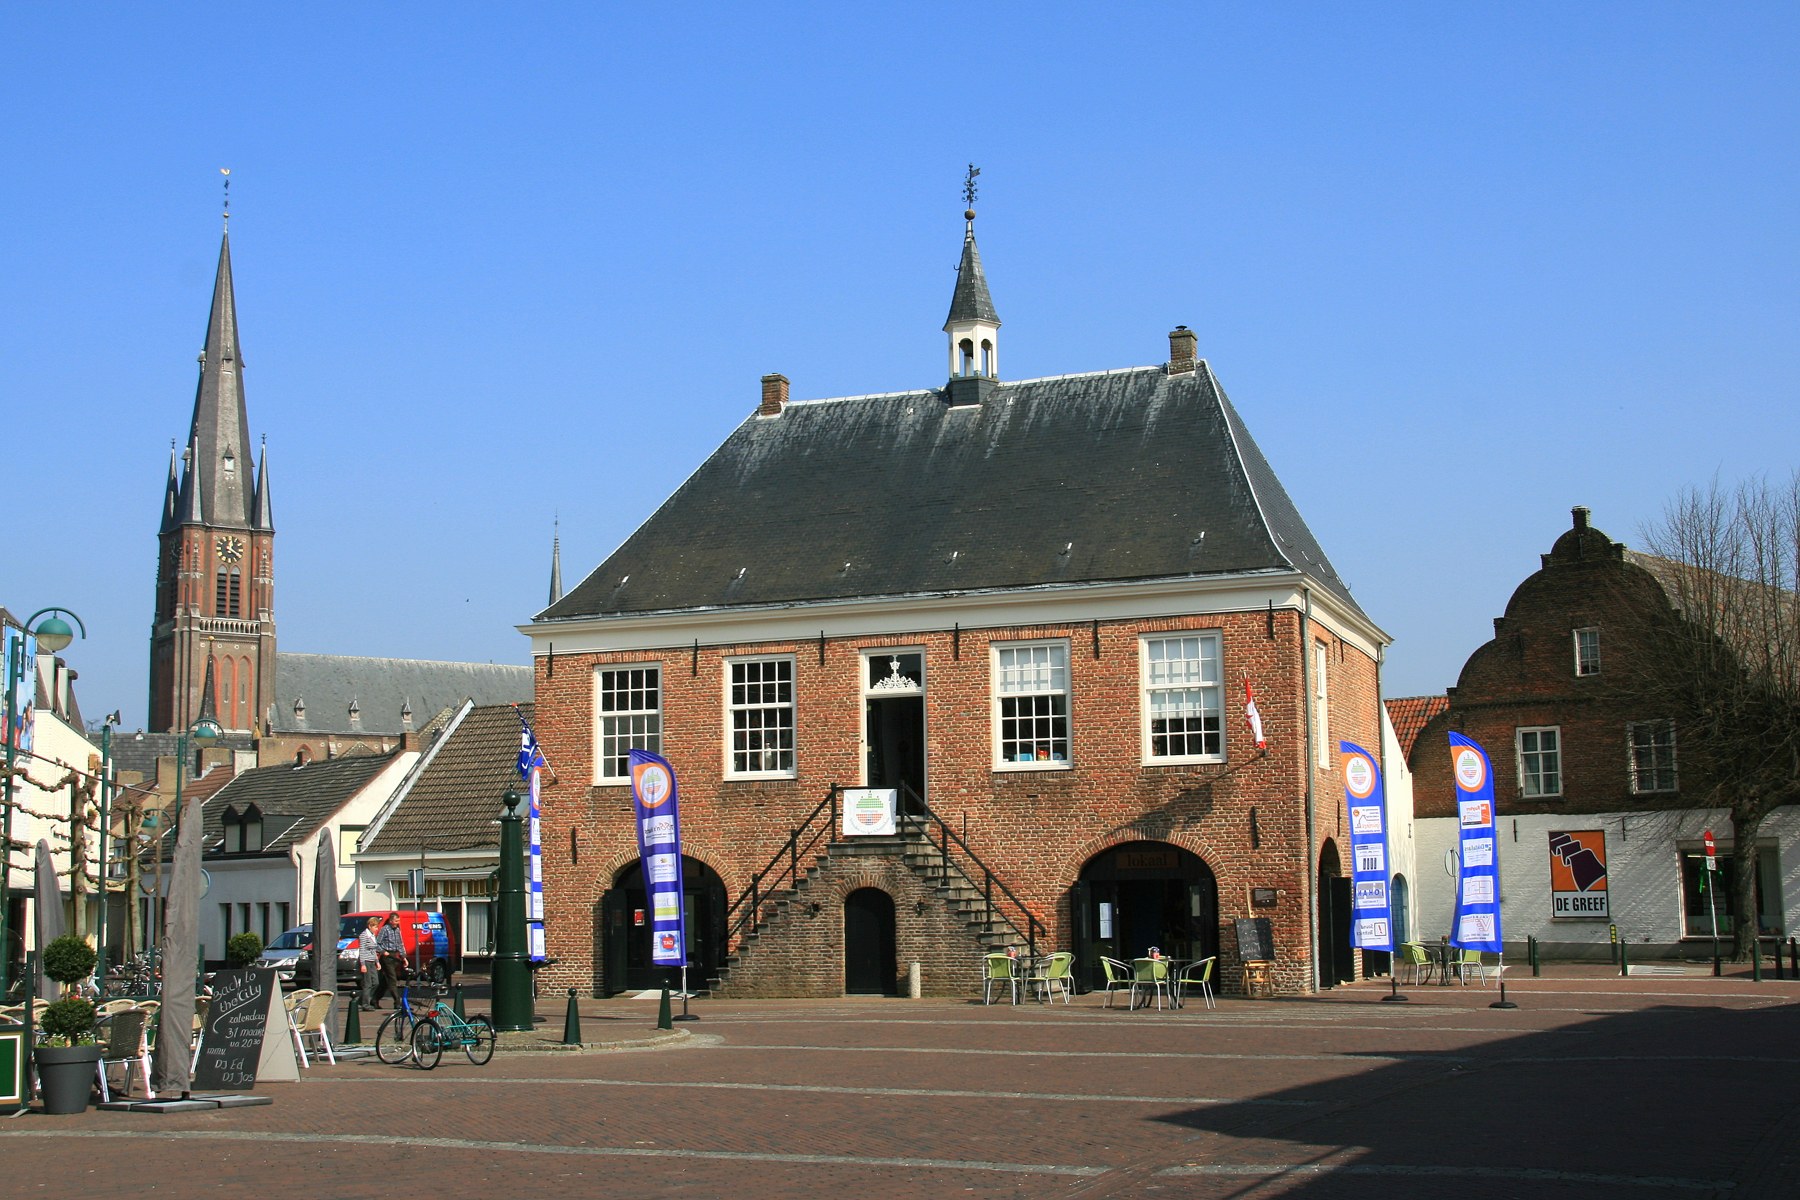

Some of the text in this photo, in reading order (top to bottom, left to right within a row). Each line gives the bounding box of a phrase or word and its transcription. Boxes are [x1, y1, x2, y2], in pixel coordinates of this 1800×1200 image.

[1127, 854, 1167, 867] lokaal
[1556, 896, 1606, 911] DE GREEF
[225, 1027, 239, 1039] 31
[214, 1057, 245, 1071] DJ Ed
[222, 1071, 254, 1086] DJ Jos
